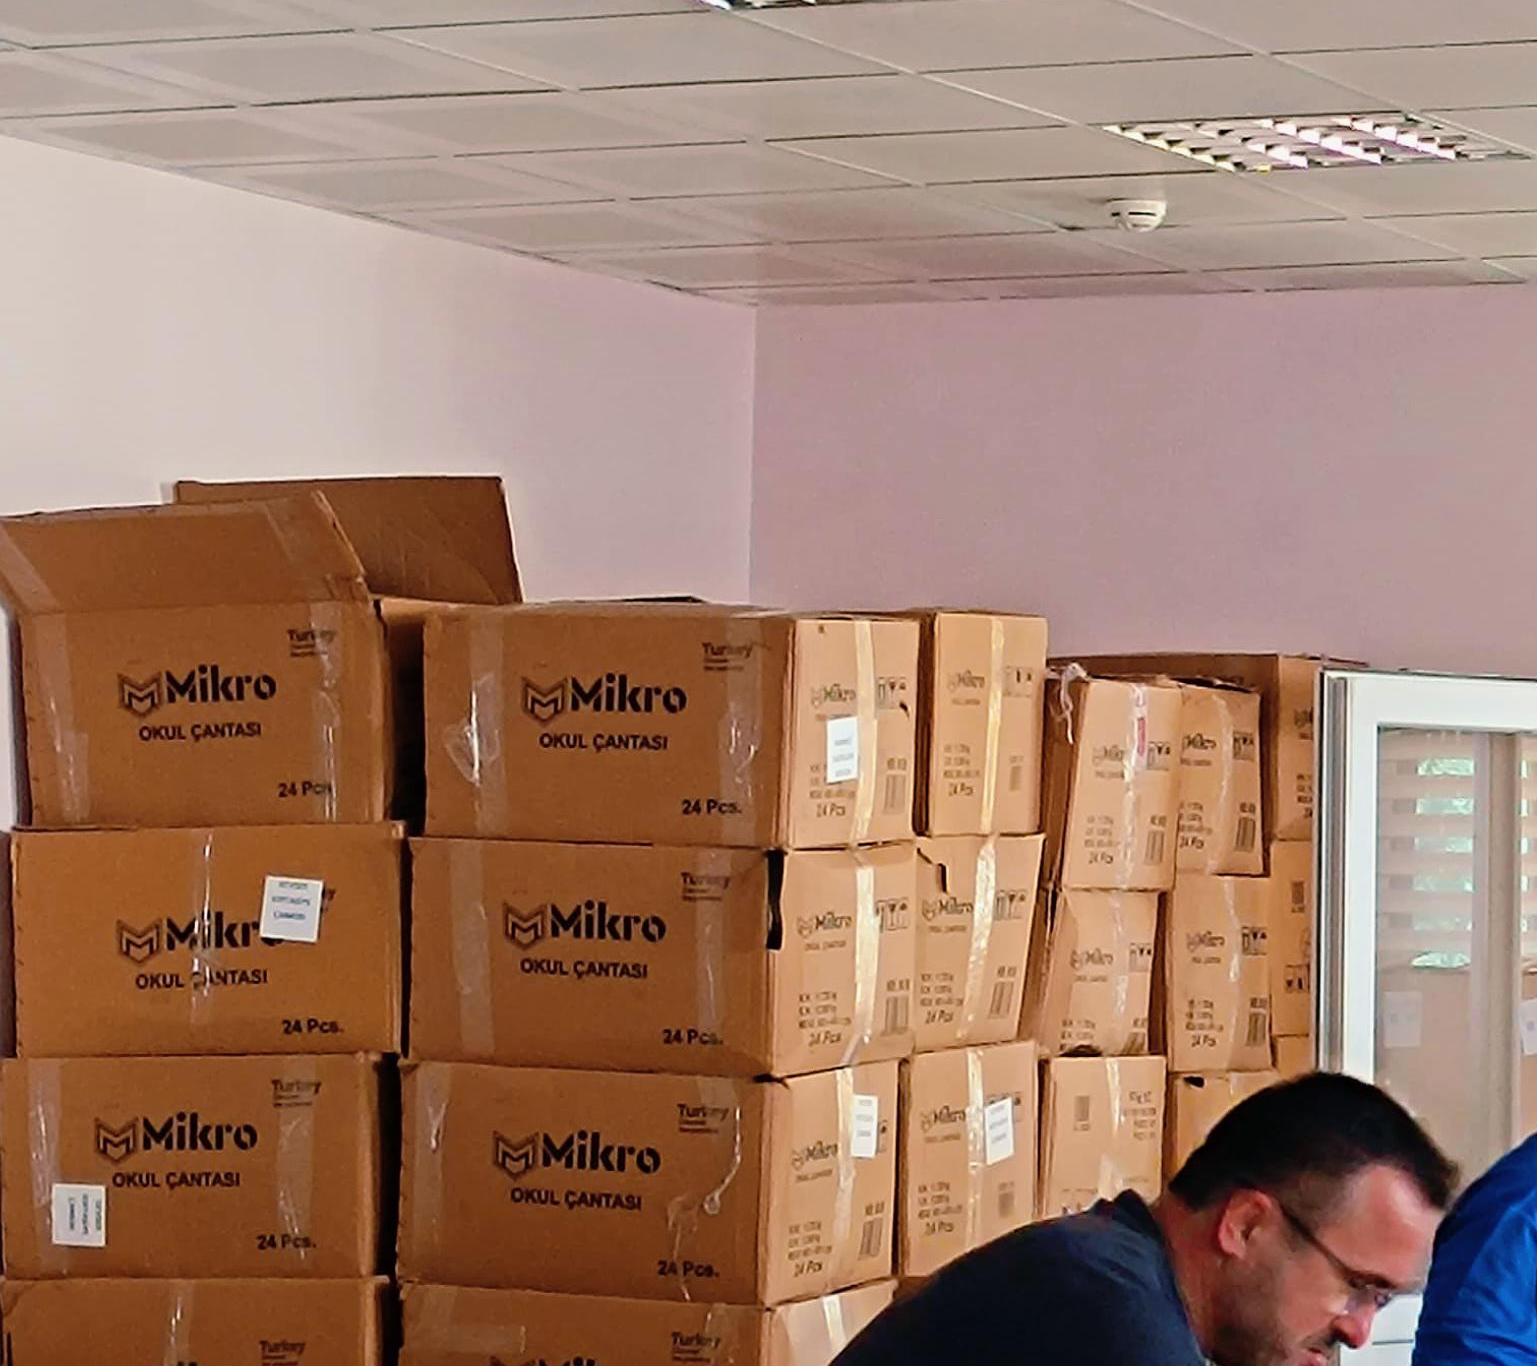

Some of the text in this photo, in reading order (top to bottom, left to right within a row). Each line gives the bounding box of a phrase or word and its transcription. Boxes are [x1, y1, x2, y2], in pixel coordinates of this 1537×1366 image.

[166, 664, 277, 703] Mikro
[571, 673, 687, 714] Mikro
[139, 722, 261, 742] OKUL ÇANTASI
[539, 734, 668, 753] OKUL ÇANTASI
[278, 783, 297, 798] 24
[682, 799, 701, 816] 24
[550, 899, 667, 943] Mikro
[166, 910, 284, 952] Mikr
[520, 958, 648, 979] OKUL ÇANTASI
[135, 973, 184, 989] OKUL
[282, 1019, 301, 1035] 24
[662, 1029, 683, 1045] 24
[143, 1112, 258, 1151] Mikro
[541, 1130, 661, 1175] Mikro
[112, 1172, 240, 1190] OKUL ÇANTASI
[511, 1187, 642, 1211] OKUL ÇANTASI
[257, 1235, 276, 1250] 24
[657, 1260, 678, 1276] 24
